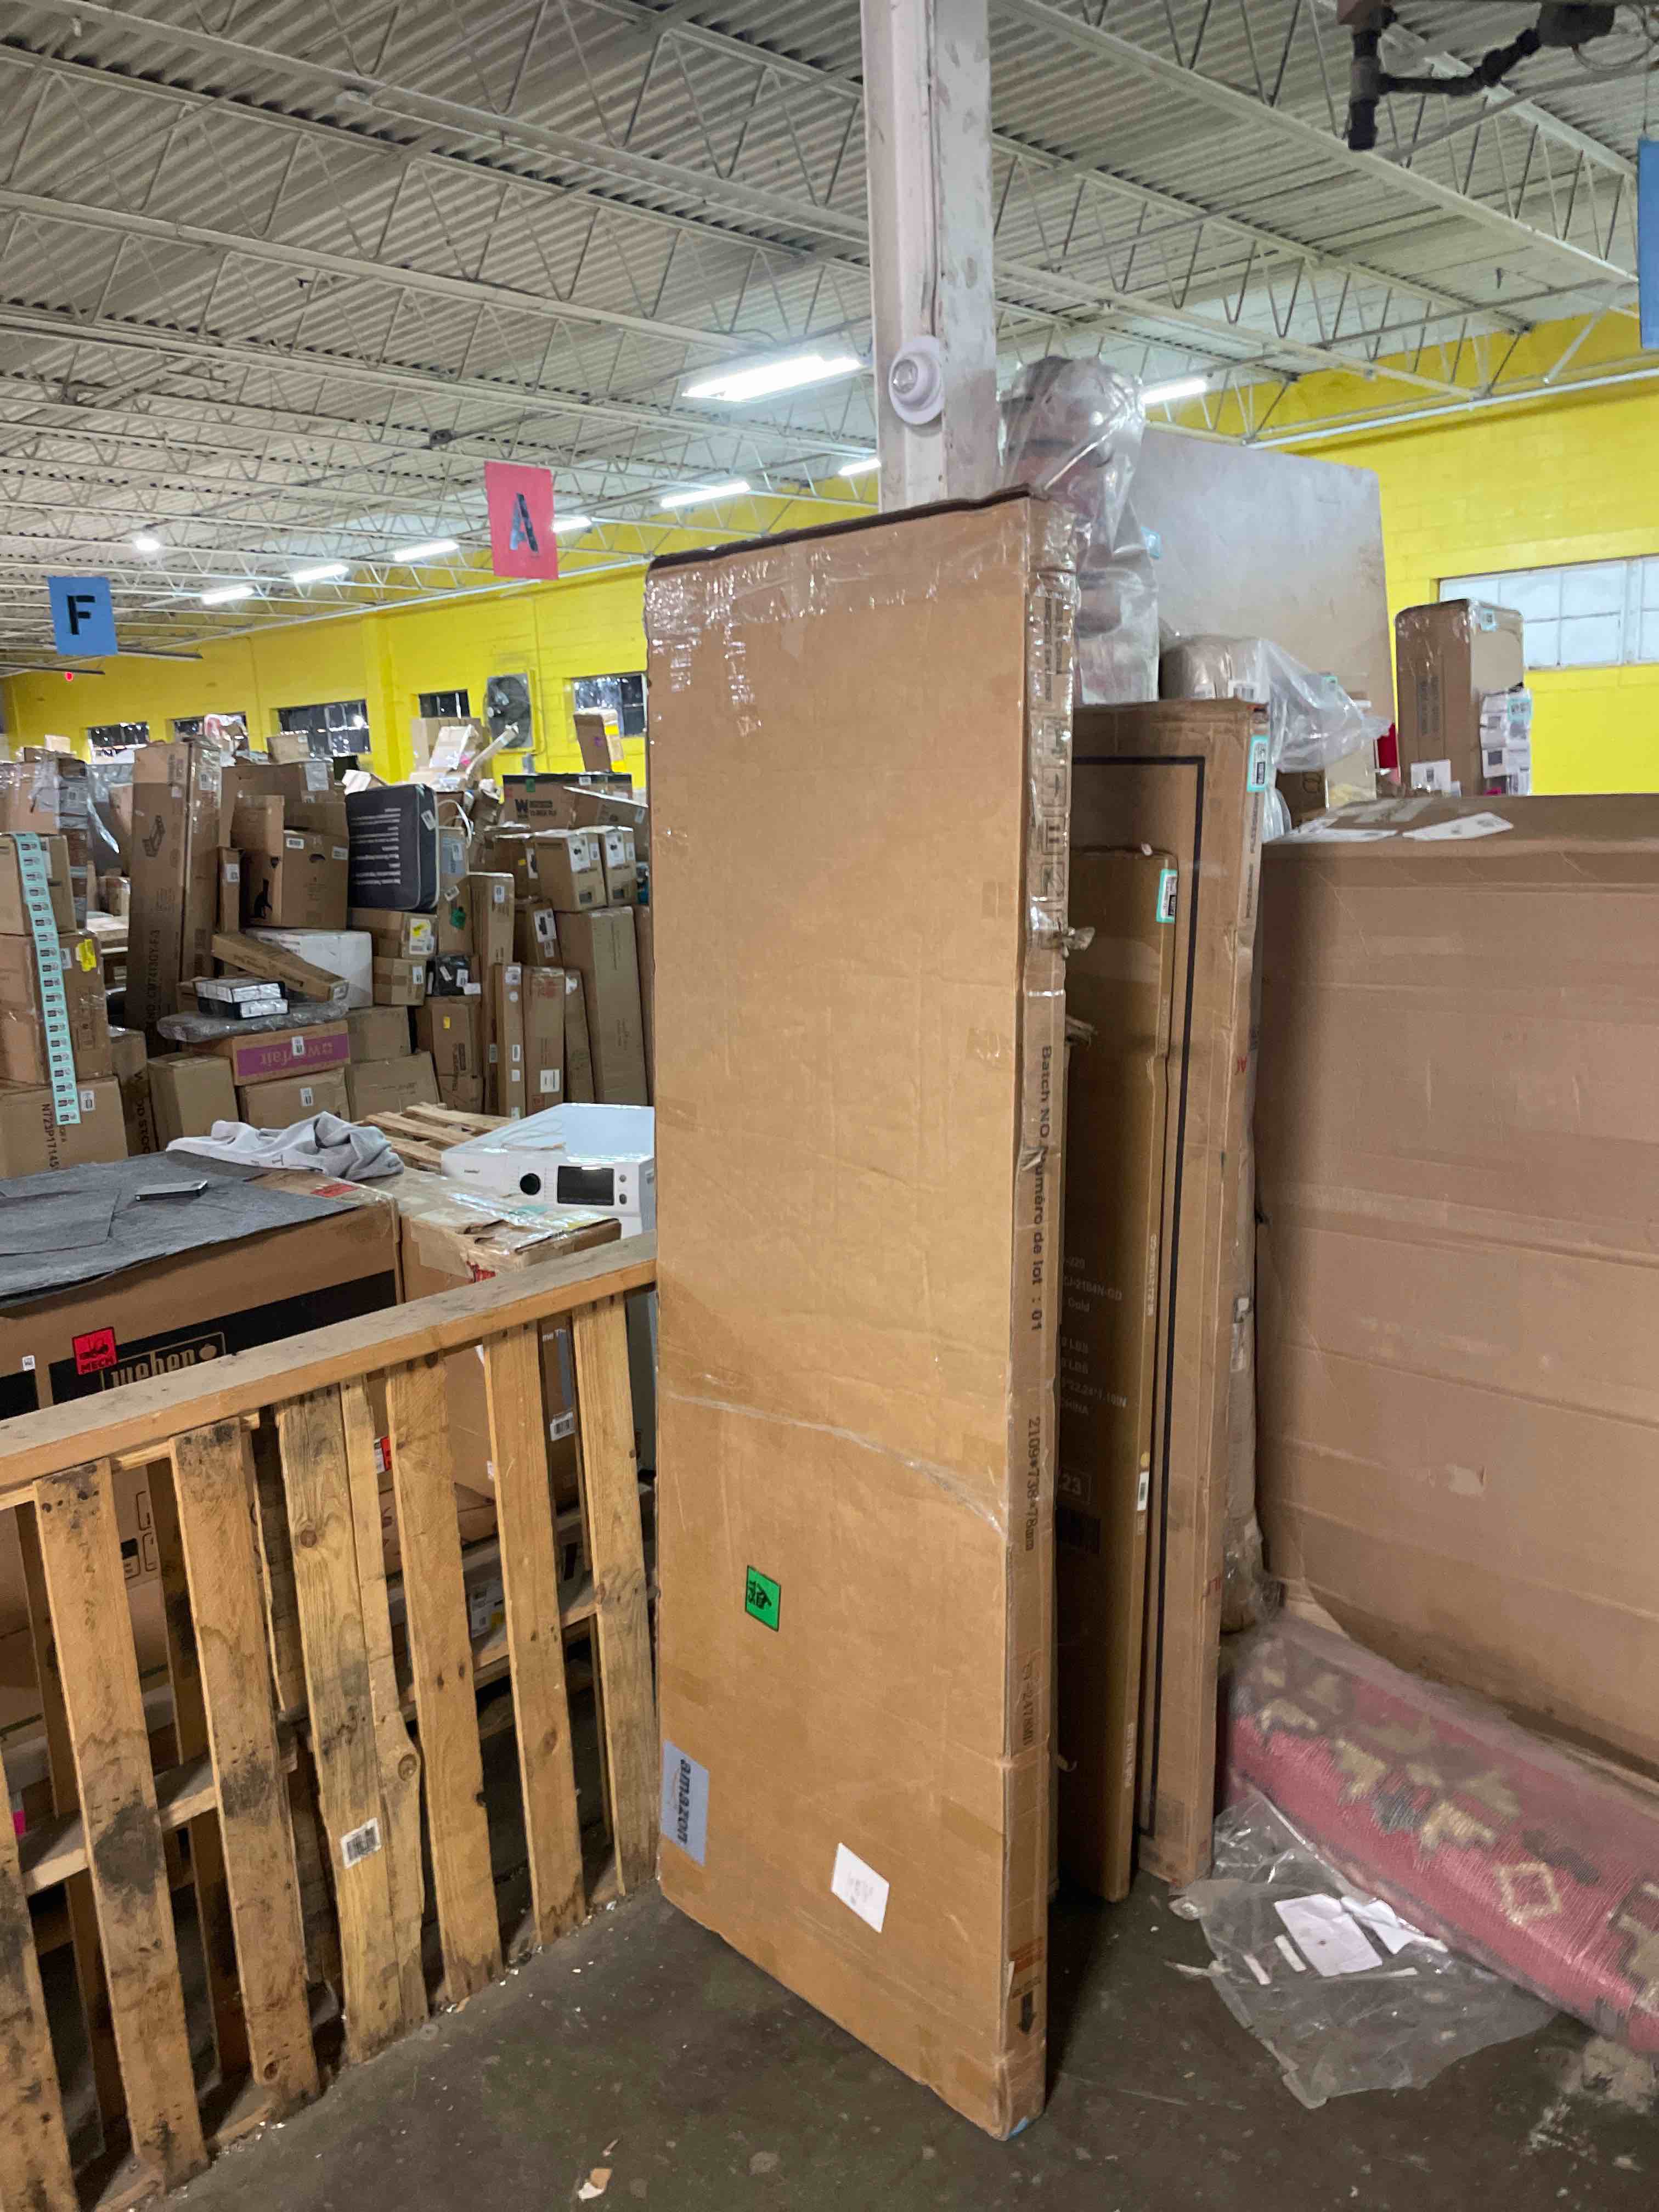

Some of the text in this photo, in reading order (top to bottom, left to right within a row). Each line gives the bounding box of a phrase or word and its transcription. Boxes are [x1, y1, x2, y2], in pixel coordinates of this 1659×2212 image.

[509, 492, 539, 555] A
[66, 594, 96, 636] F
[1040, 1045, 1052, 1103] Batch
[1031, 1232, 1044, 1255] de
[1031, 1260, 1043, 1285] lot
[1031, 1311, 1042, 1331] 01
[678, 1758, 693, 1845] amazon
